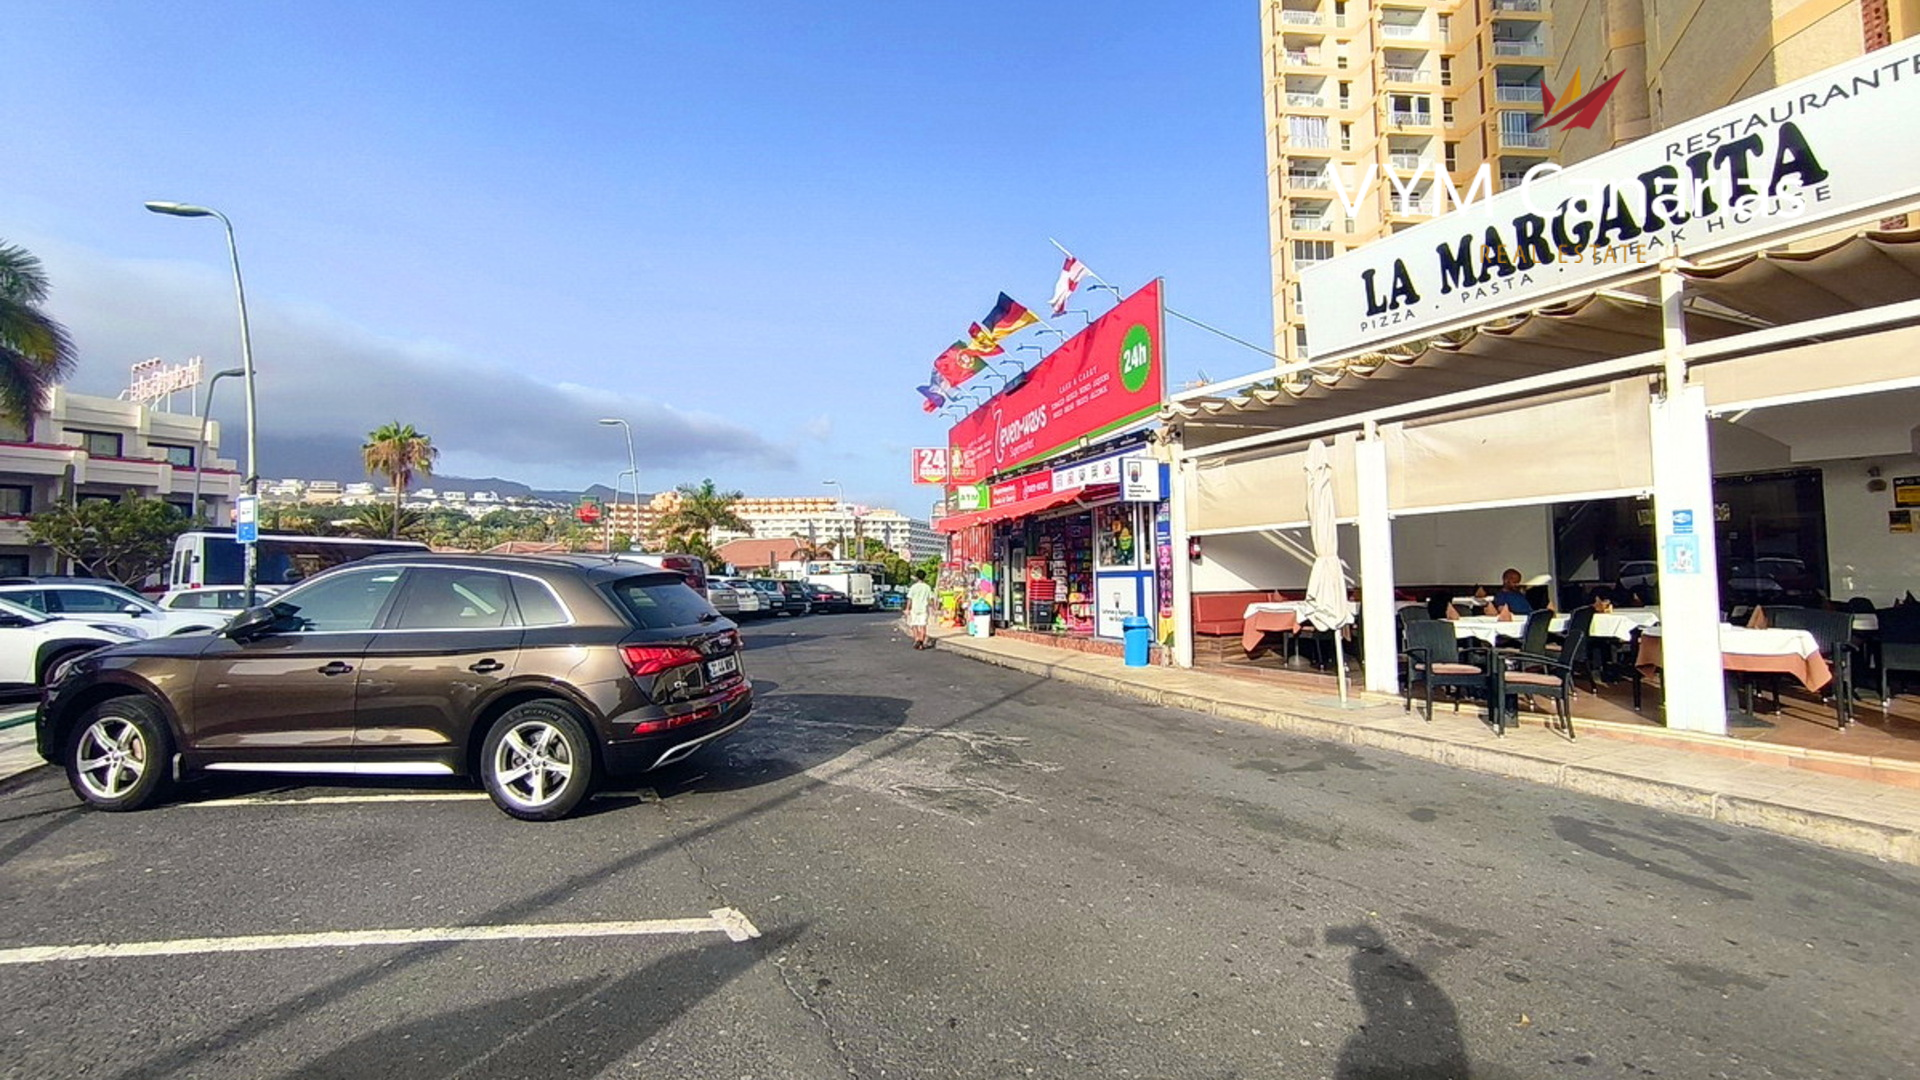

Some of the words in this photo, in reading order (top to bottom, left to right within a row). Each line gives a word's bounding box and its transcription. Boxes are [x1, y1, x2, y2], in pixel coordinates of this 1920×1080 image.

[1362, 258, 1420, 316] LA
[1436, 121, 1829, 294] MARGARITA
[1360, 308, 1415, 332] PIZZA
[1462, 272, 1534, 303] PASTA
[1592, 228, 1687, 266] STEAK
[1123, 342, 1147, 374] 24h
[919, 450, 945, 468] 24
